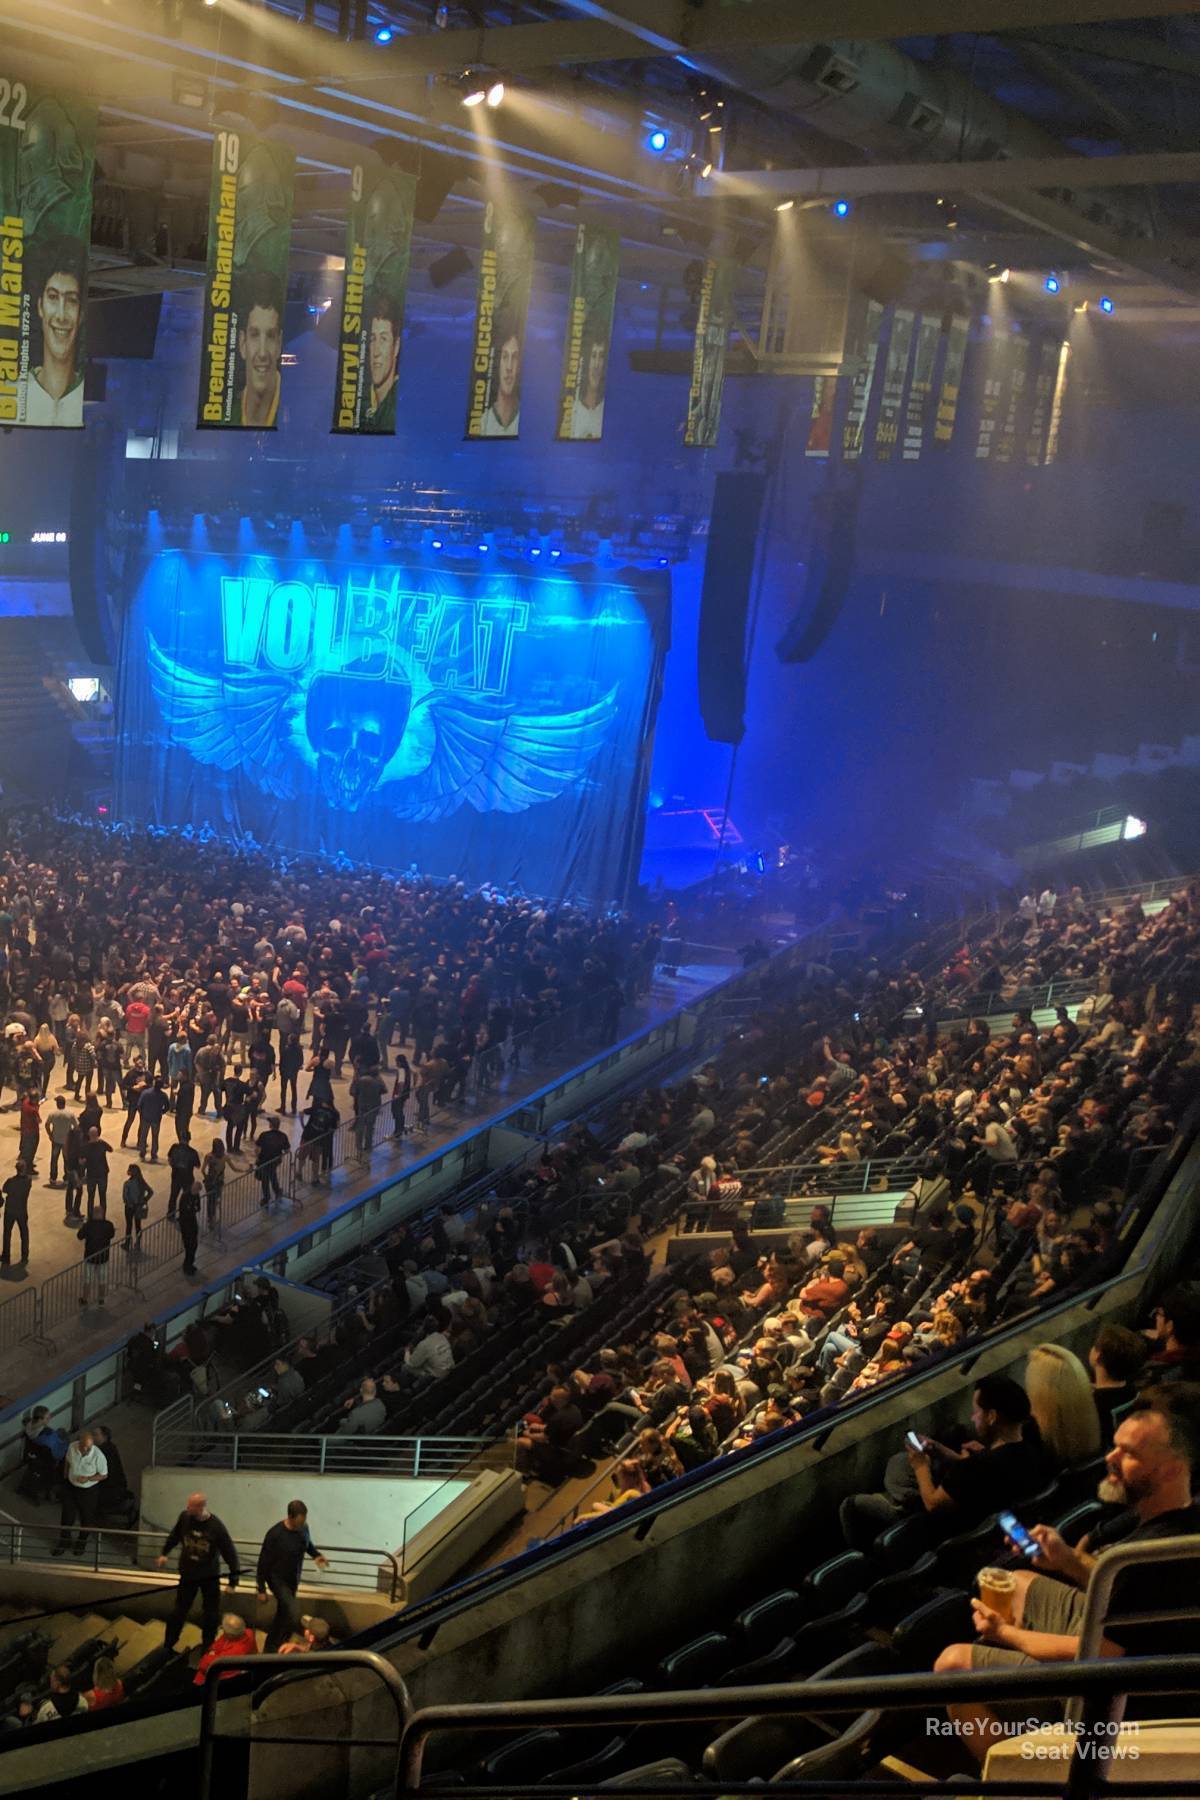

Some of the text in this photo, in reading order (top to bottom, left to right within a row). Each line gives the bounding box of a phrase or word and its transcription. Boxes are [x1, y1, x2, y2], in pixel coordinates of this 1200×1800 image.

[218, 131, 240, 174] 19
[352, 165, 363, 202] 9
[203, 174, 238, 422] Brendan Shanahan
[338, 241, 367, 430] Darryl Sittler
[474, 249, 497, 373] Ciccarelli
[19, 339, 30, 381] Knights
[468, 378, 486, 436] Dino
[220, 575, 530, 697] VOLBEAT
